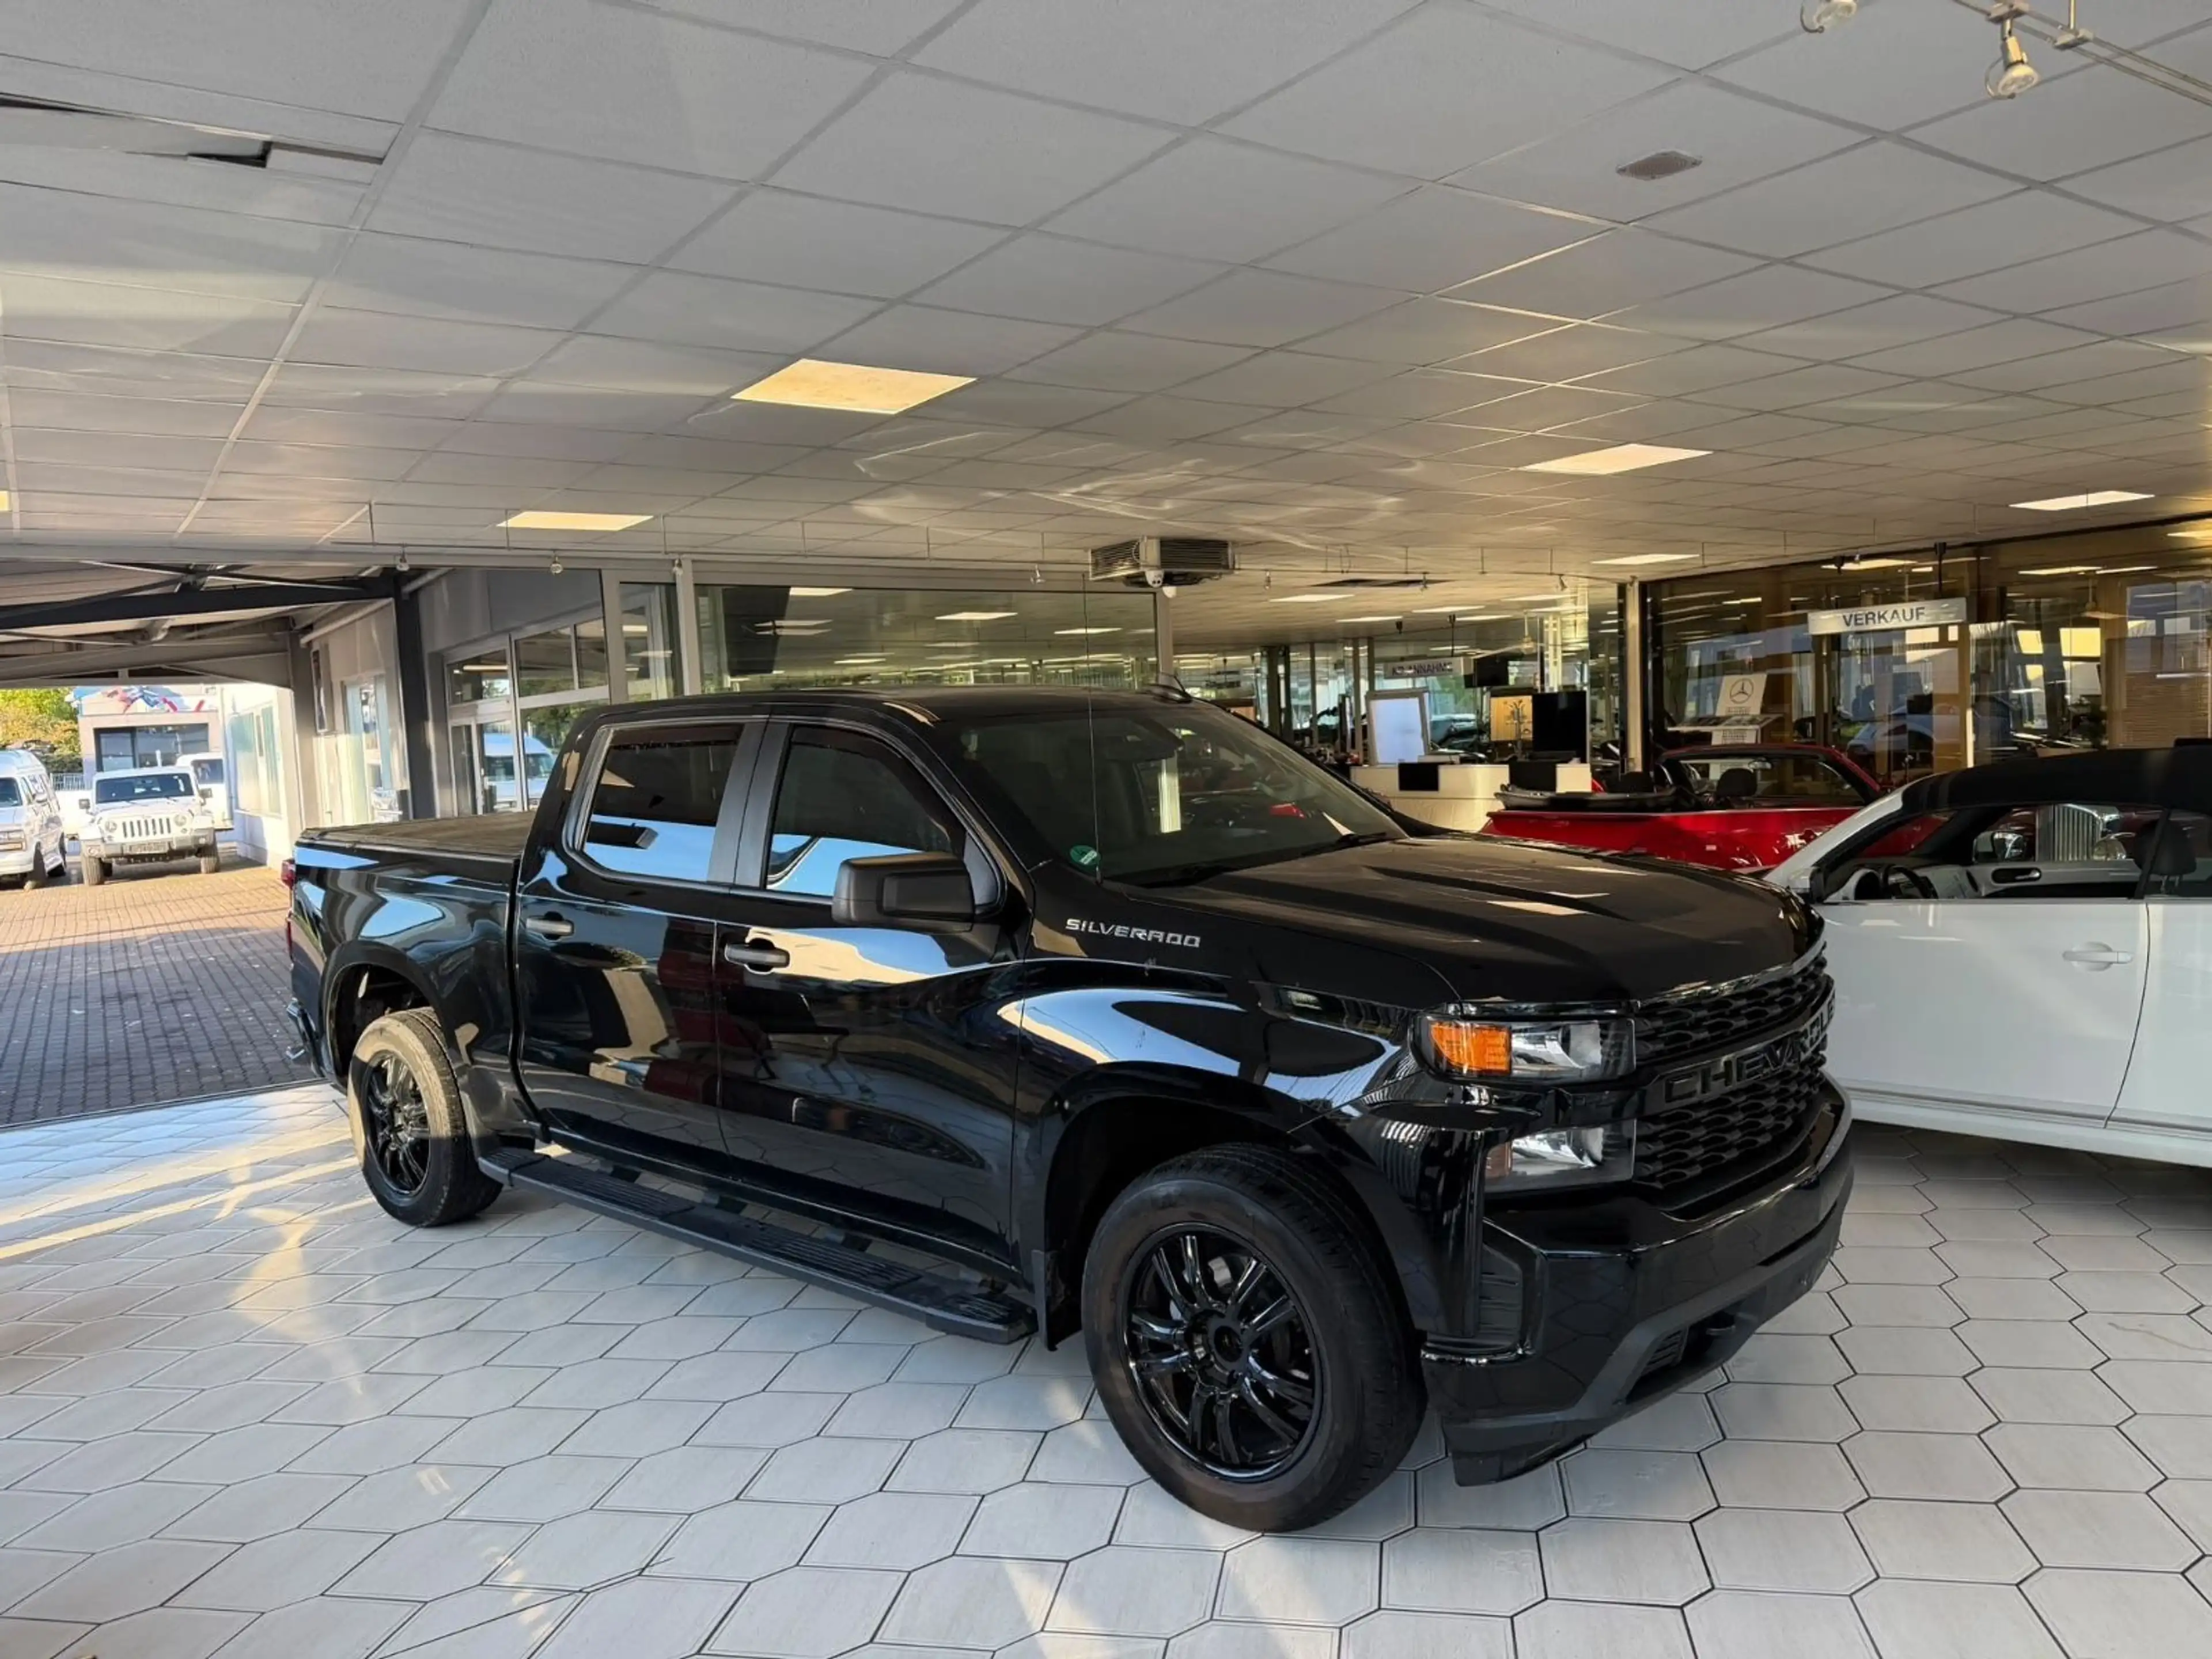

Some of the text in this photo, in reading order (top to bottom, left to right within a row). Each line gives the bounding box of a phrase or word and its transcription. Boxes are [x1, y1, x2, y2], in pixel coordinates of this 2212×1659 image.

[1843, 607, 1925, 627] VERKAUF
[1065, 918, 1201, 948] SILVERADO
[1664, 993, 1835, 1104] CHEVROLE
